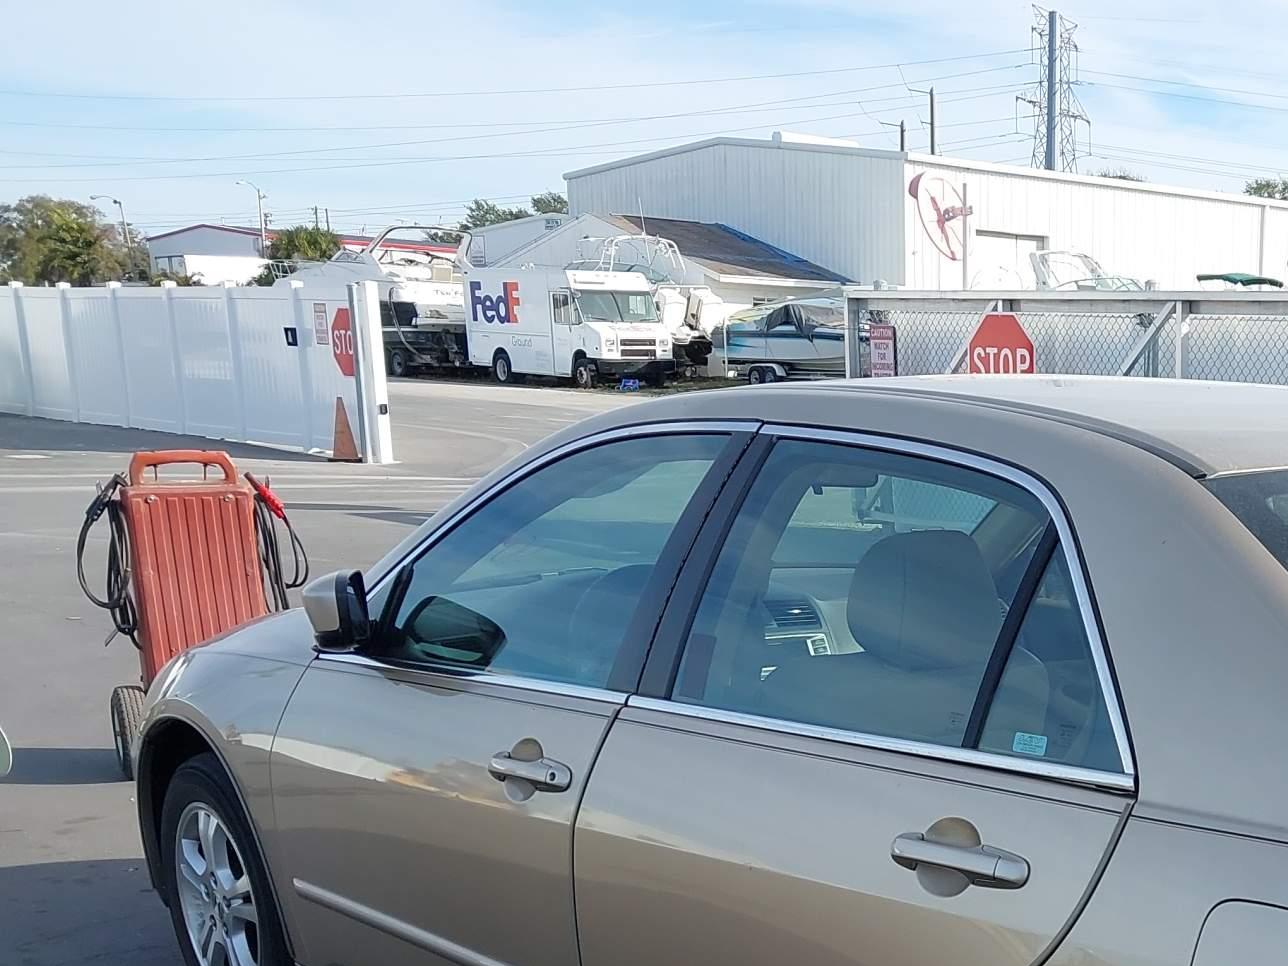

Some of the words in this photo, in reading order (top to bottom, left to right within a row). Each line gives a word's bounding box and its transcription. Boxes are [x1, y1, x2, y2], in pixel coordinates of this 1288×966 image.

[333, 330, 354, 355] STO
[870, 327, 892, 337] CAUTION
[972, 346, 1031, 374] STOP
